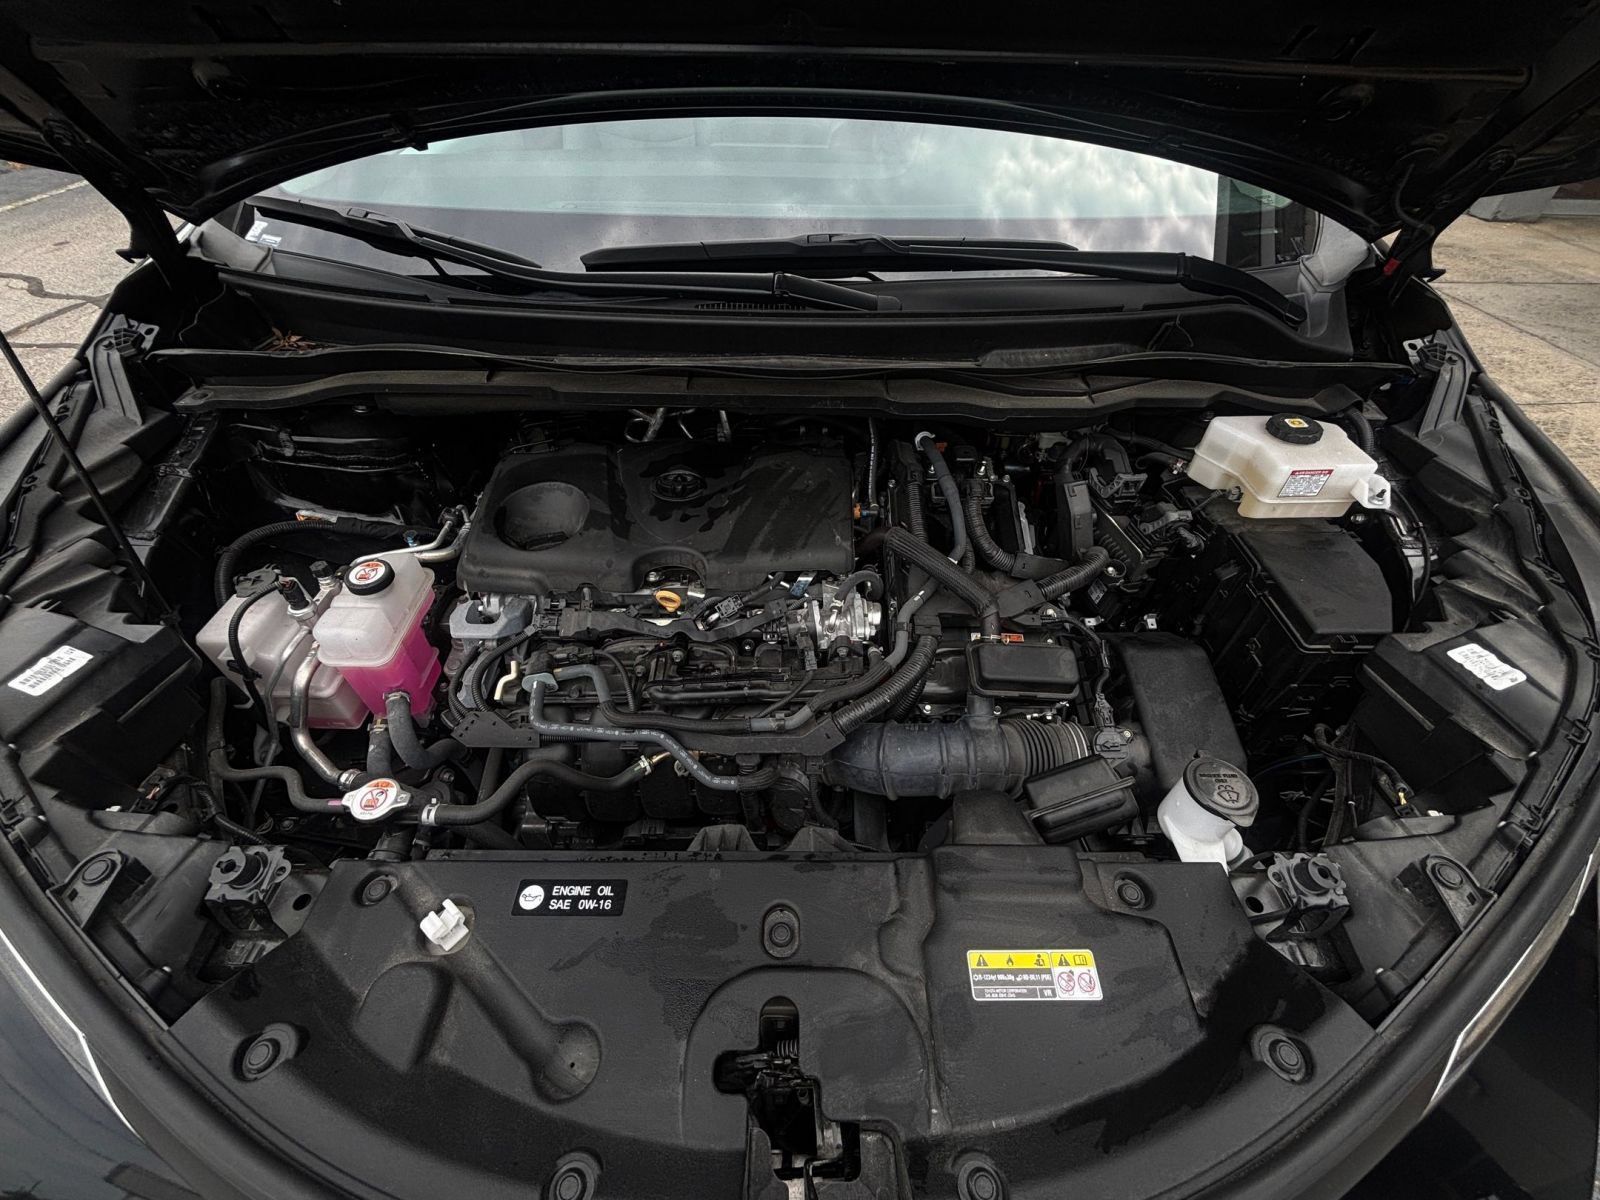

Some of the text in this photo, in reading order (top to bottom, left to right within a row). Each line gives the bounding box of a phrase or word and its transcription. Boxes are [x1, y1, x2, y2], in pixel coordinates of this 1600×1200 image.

[552, 885, 614, 896] ENGINE OIL
[548, 899, 612, 910] SAE 0W-16
